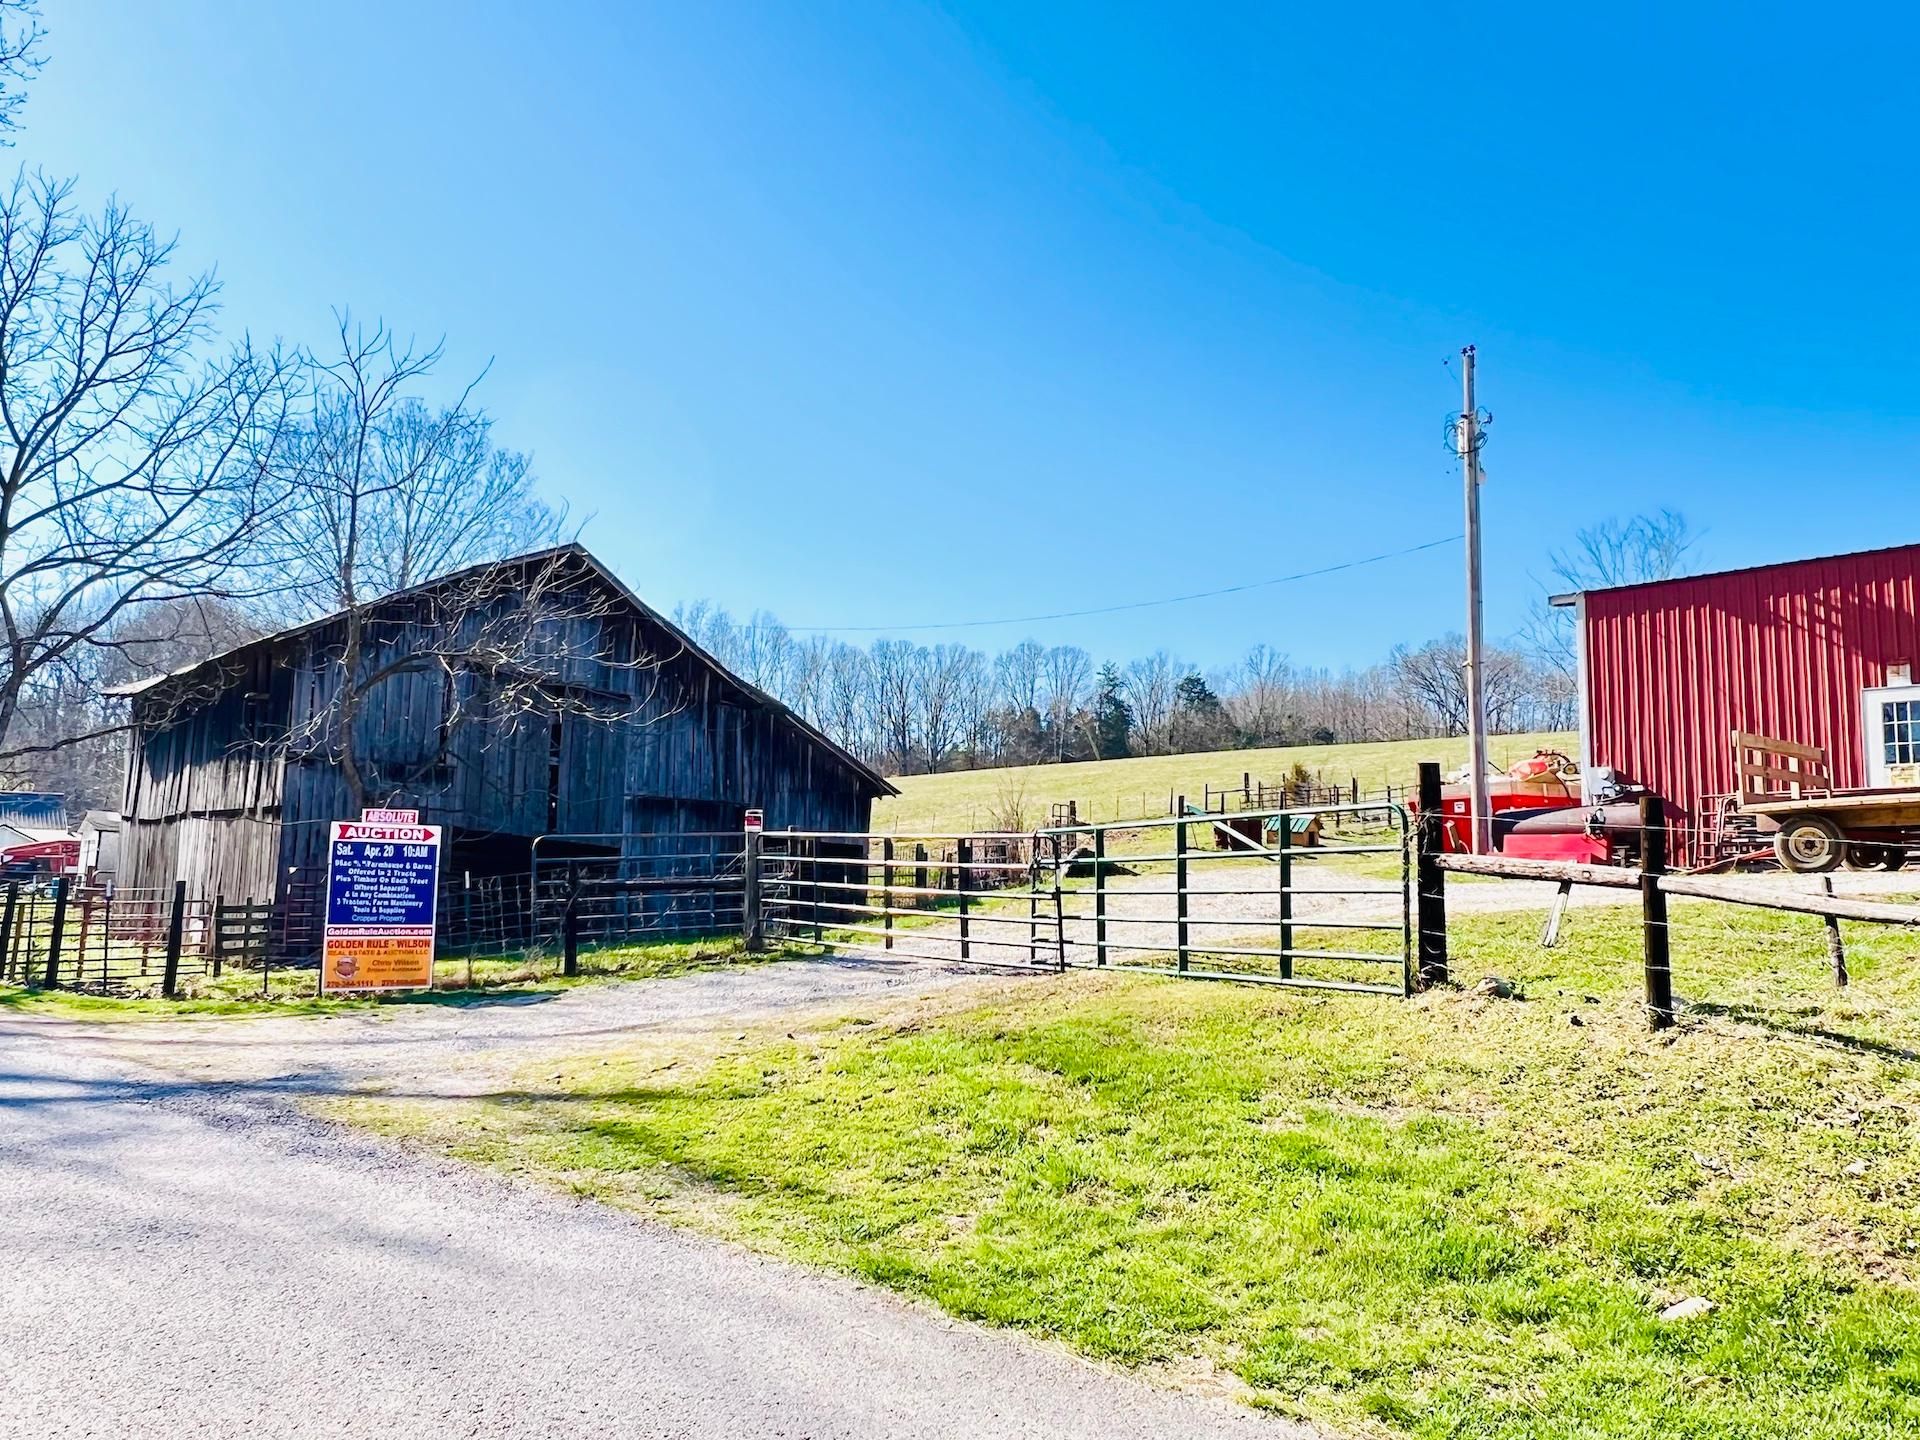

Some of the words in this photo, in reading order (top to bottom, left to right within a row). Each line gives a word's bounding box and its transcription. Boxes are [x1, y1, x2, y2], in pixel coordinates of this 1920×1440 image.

[366, 811, 415, 822] ABSOLUTE
[345, 827, 425, 840] AUCTION
[337, 843, 354, 855] Sat.
[364, 844, 381, 859] Apr.
[383, 845, 394, 857] 20
[403, 845, 428, 858] 10:AM
[348, 868, 376, 876] Offered
[387, 869, 392, 877] 2
[394, 869, 416, 877] Tracts
[410, 877, 428, 885] Tract
[379, 884, 409, 893] Separately
[360, 891, 372, 899] Any
[390, 899, 423, 908] Machinery
[379, 914, 406, 923] Property
[327, 928, 432, 936] GoldenRuleAuction.com
[327, 940, 364, 949] GOLDEN
[366, 940, 389, 948] RULE
[397, 940, 431, 948] WILSON
